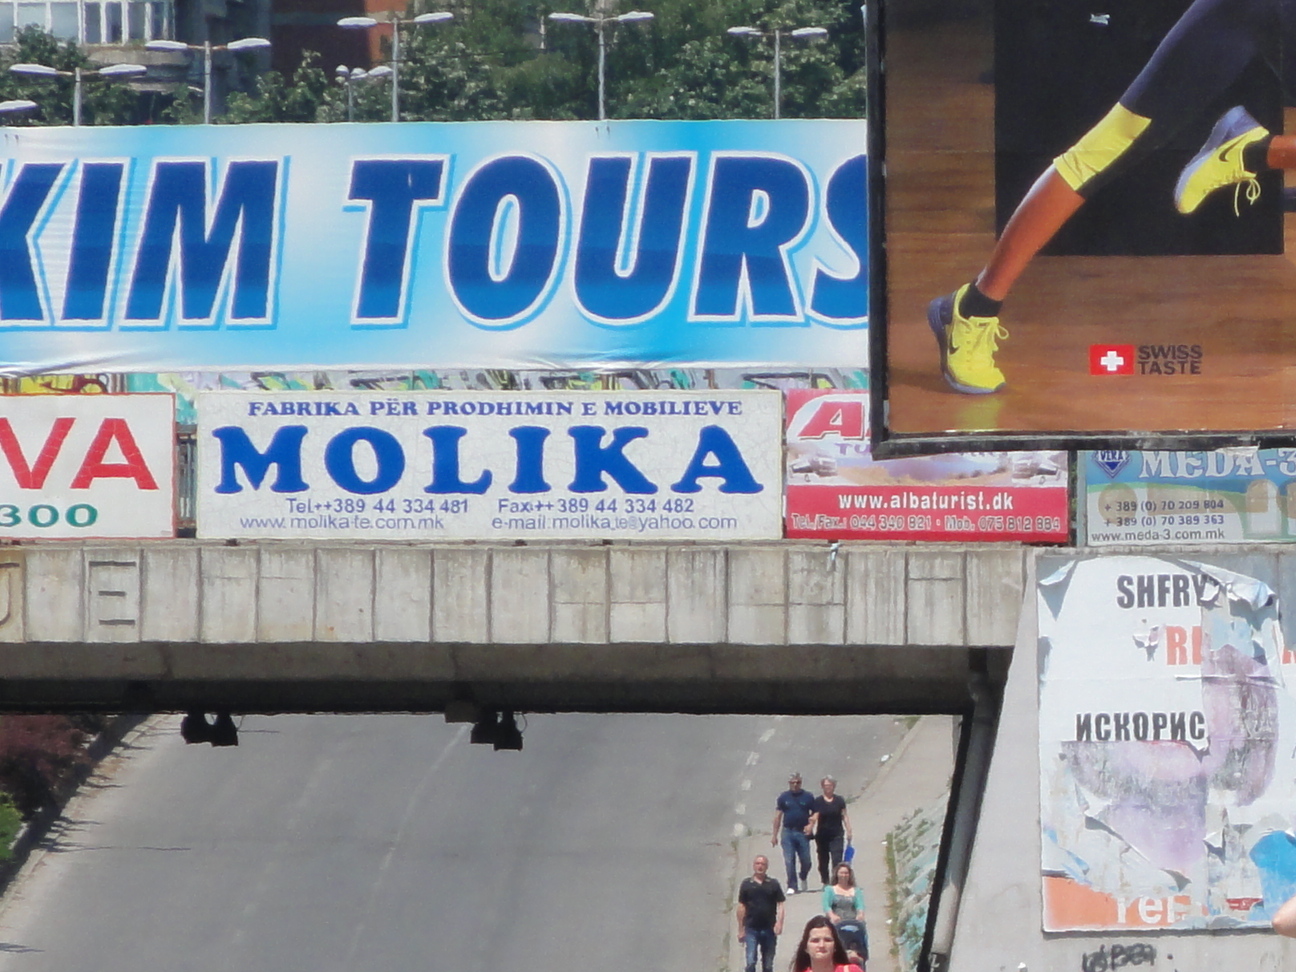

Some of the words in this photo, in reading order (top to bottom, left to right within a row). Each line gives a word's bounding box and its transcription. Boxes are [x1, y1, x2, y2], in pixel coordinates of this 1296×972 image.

[346, 153, 868, 327] TOURS
[1138, 344, 1203, 360] SWISS
[1137, 360, 1201, 375] TASTE
[248, 401, 360, 416] FABRIKA
[370, 397, 418, 416] PËR
[427, 400, 574, 416] PRODHIMIN
[581, 401, 597, 416] E
[604, 400, 743, 416] MOBILIEVE
[211, 424, 765, 495] MOLIKA
[372, 498, 396, 514] 44
[403, 498, 435, 514] 334
[440, 498, 469, 514] 481
[595, 498, 618, 514] 44
[624, 498, 657, 514] 334
[662, 498, 695, 514] 482
[838, 491, 1014, 511] www.albaturist.dk
[1115, 499, 1138, 512] 389
[1140, 500, 1157, 513] (0)
[1178, 500, 1200, 510] 209
[851, 514, 876, 530] 044
[944, 515, 975, 532] Mob.
[1115, 515, 1138, 527] 389
[1140, 515, 1157, 527] (0)
[1178, 514, 1200, 526] 389
[1203, 514, 1225, 525] 363
[1075, 711, 1206, 742] ИСКОРИС
